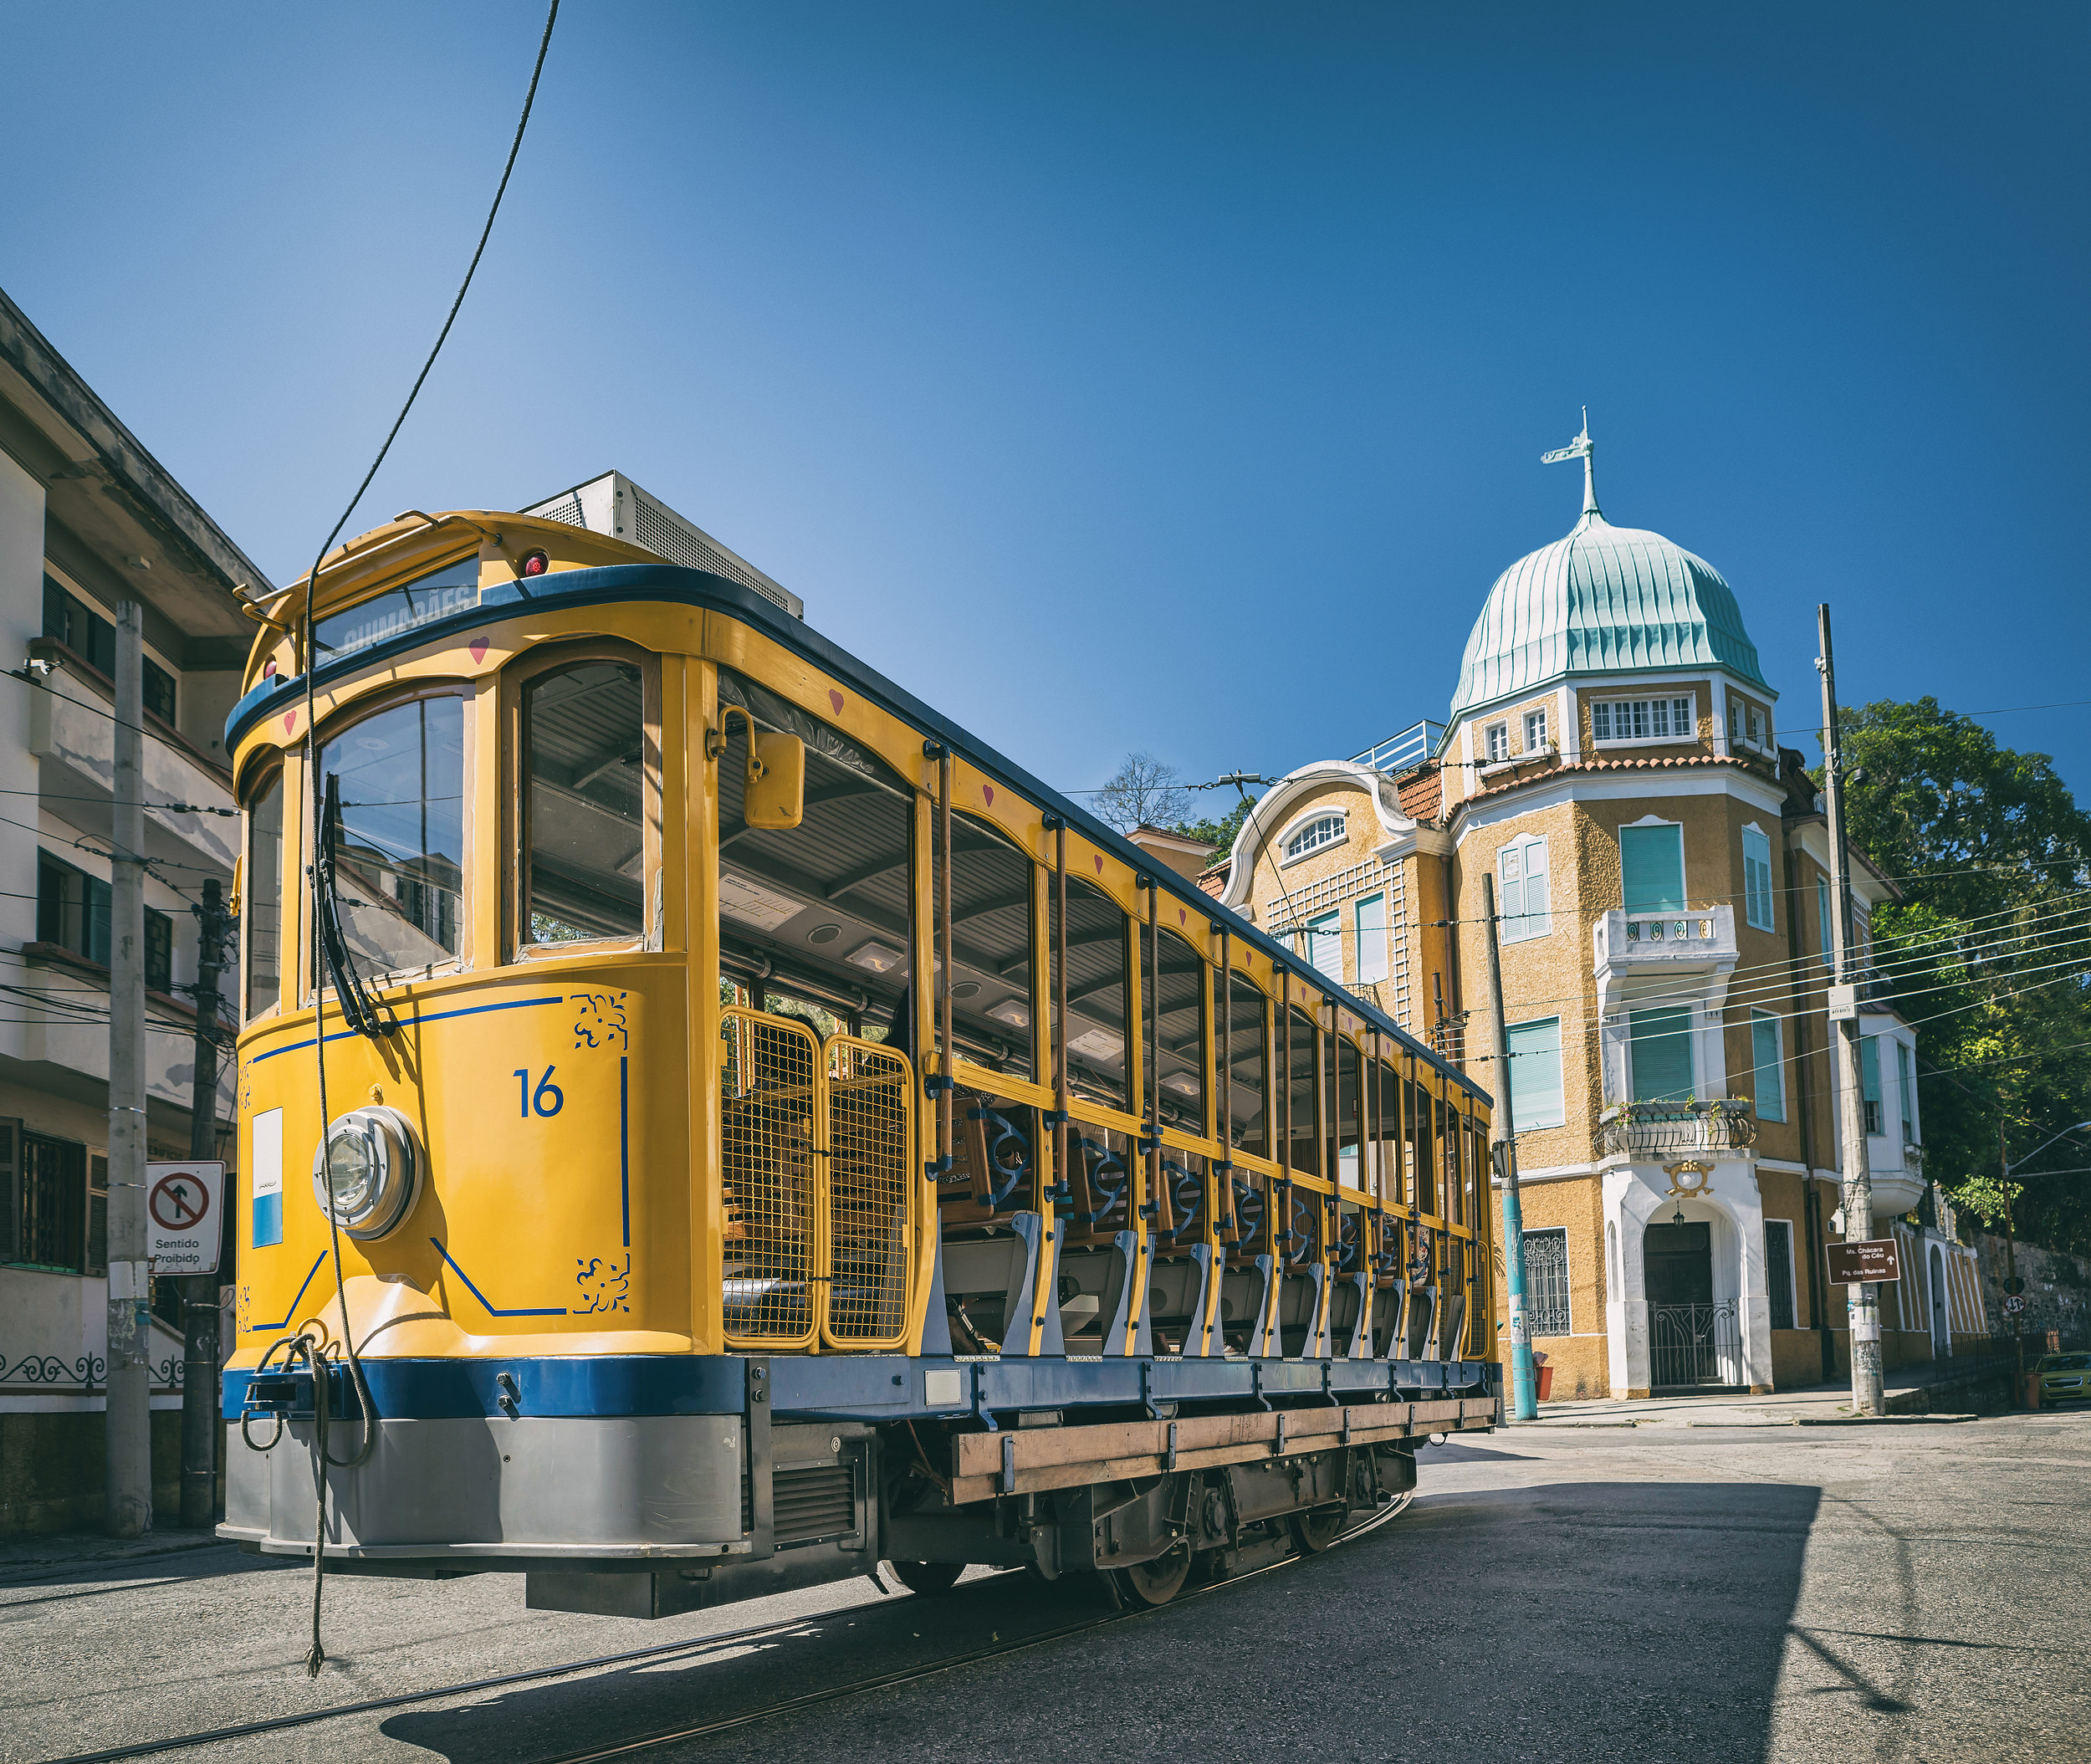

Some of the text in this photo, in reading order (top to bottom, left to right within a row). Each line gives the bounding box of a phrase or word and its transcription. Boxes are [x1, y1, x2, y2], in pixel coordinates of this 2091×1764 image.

[513, 1064, 564, 1117] 16
[155, 1239, 200, 1249] Sentido
[155, 1253, 200, 1263] Proibido
